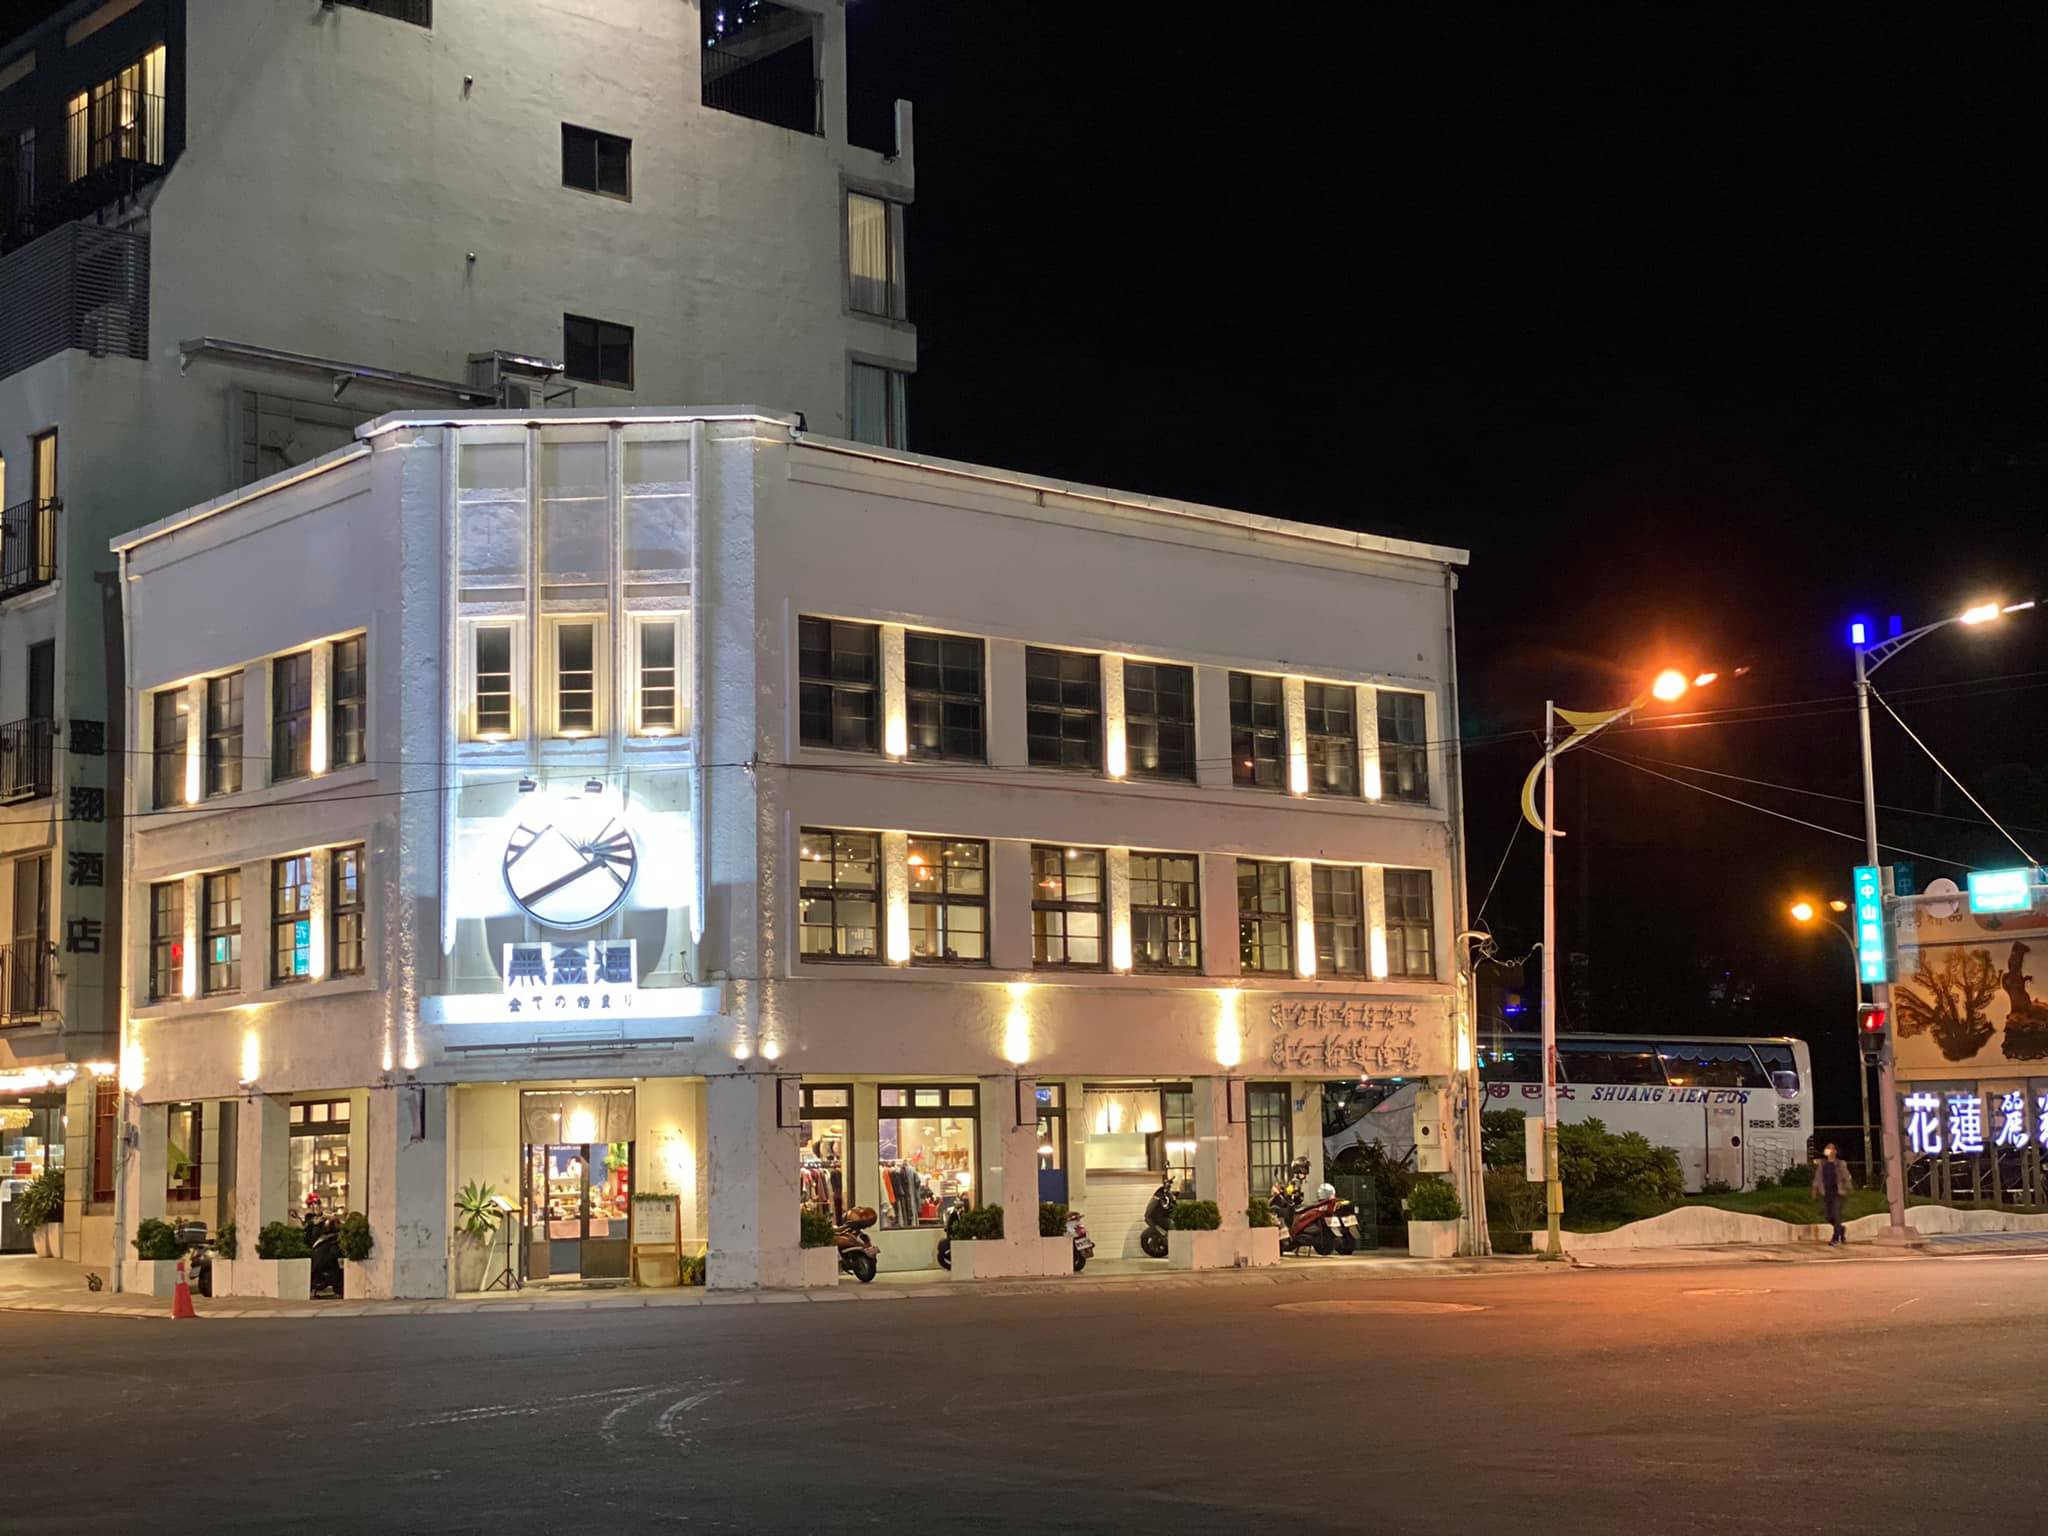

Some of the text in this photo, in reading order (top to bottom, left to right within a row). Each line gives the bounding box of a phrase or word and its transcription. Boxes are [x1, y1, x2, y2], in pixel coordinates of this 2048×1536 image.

[1591, 1086, 1751, 1105] SHUANG TIEN BUS
